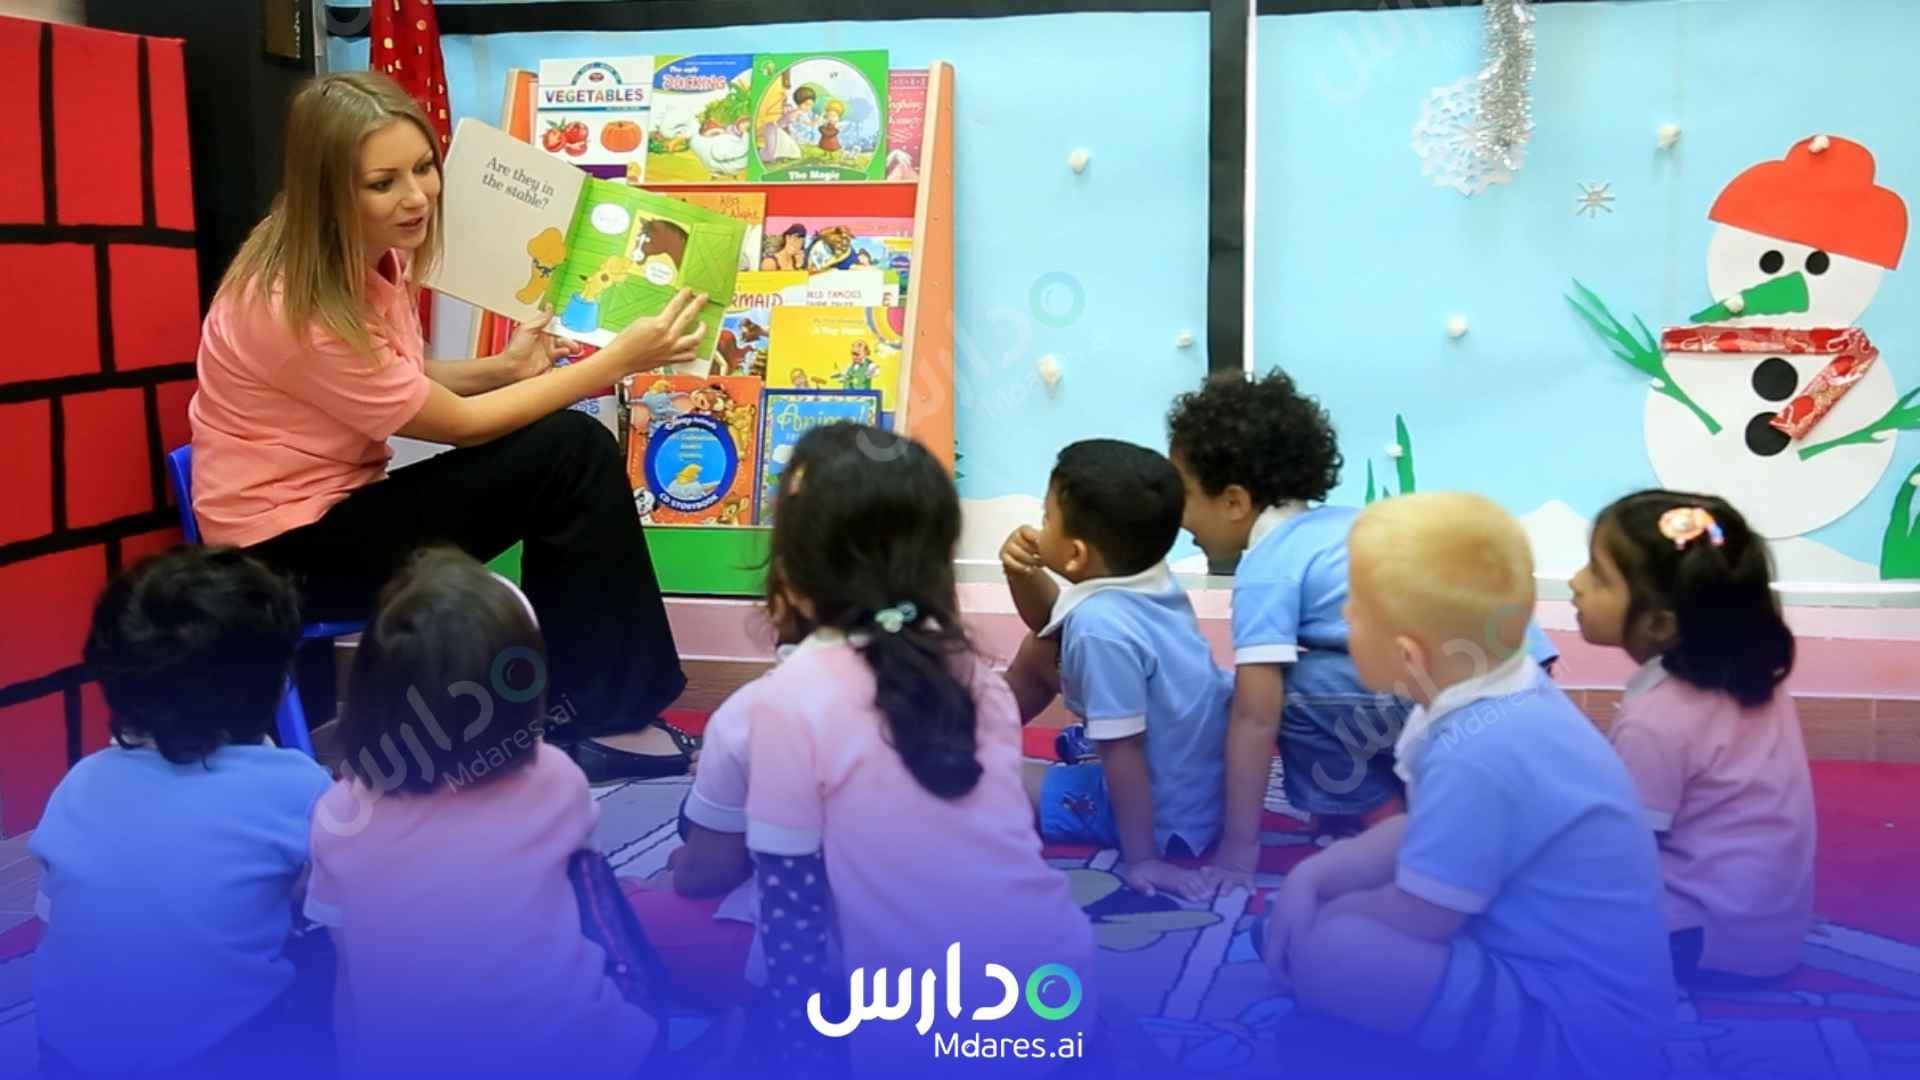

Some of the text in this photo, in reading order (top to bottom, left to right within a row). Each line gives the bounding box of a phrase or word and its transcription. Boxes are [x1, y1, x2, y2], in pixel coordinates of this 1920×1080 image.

[545, 88, 645, 104] VEGETABLES
[482, 172, 549, 210] the stable?
[486, 157, 554, 197] Are they in
